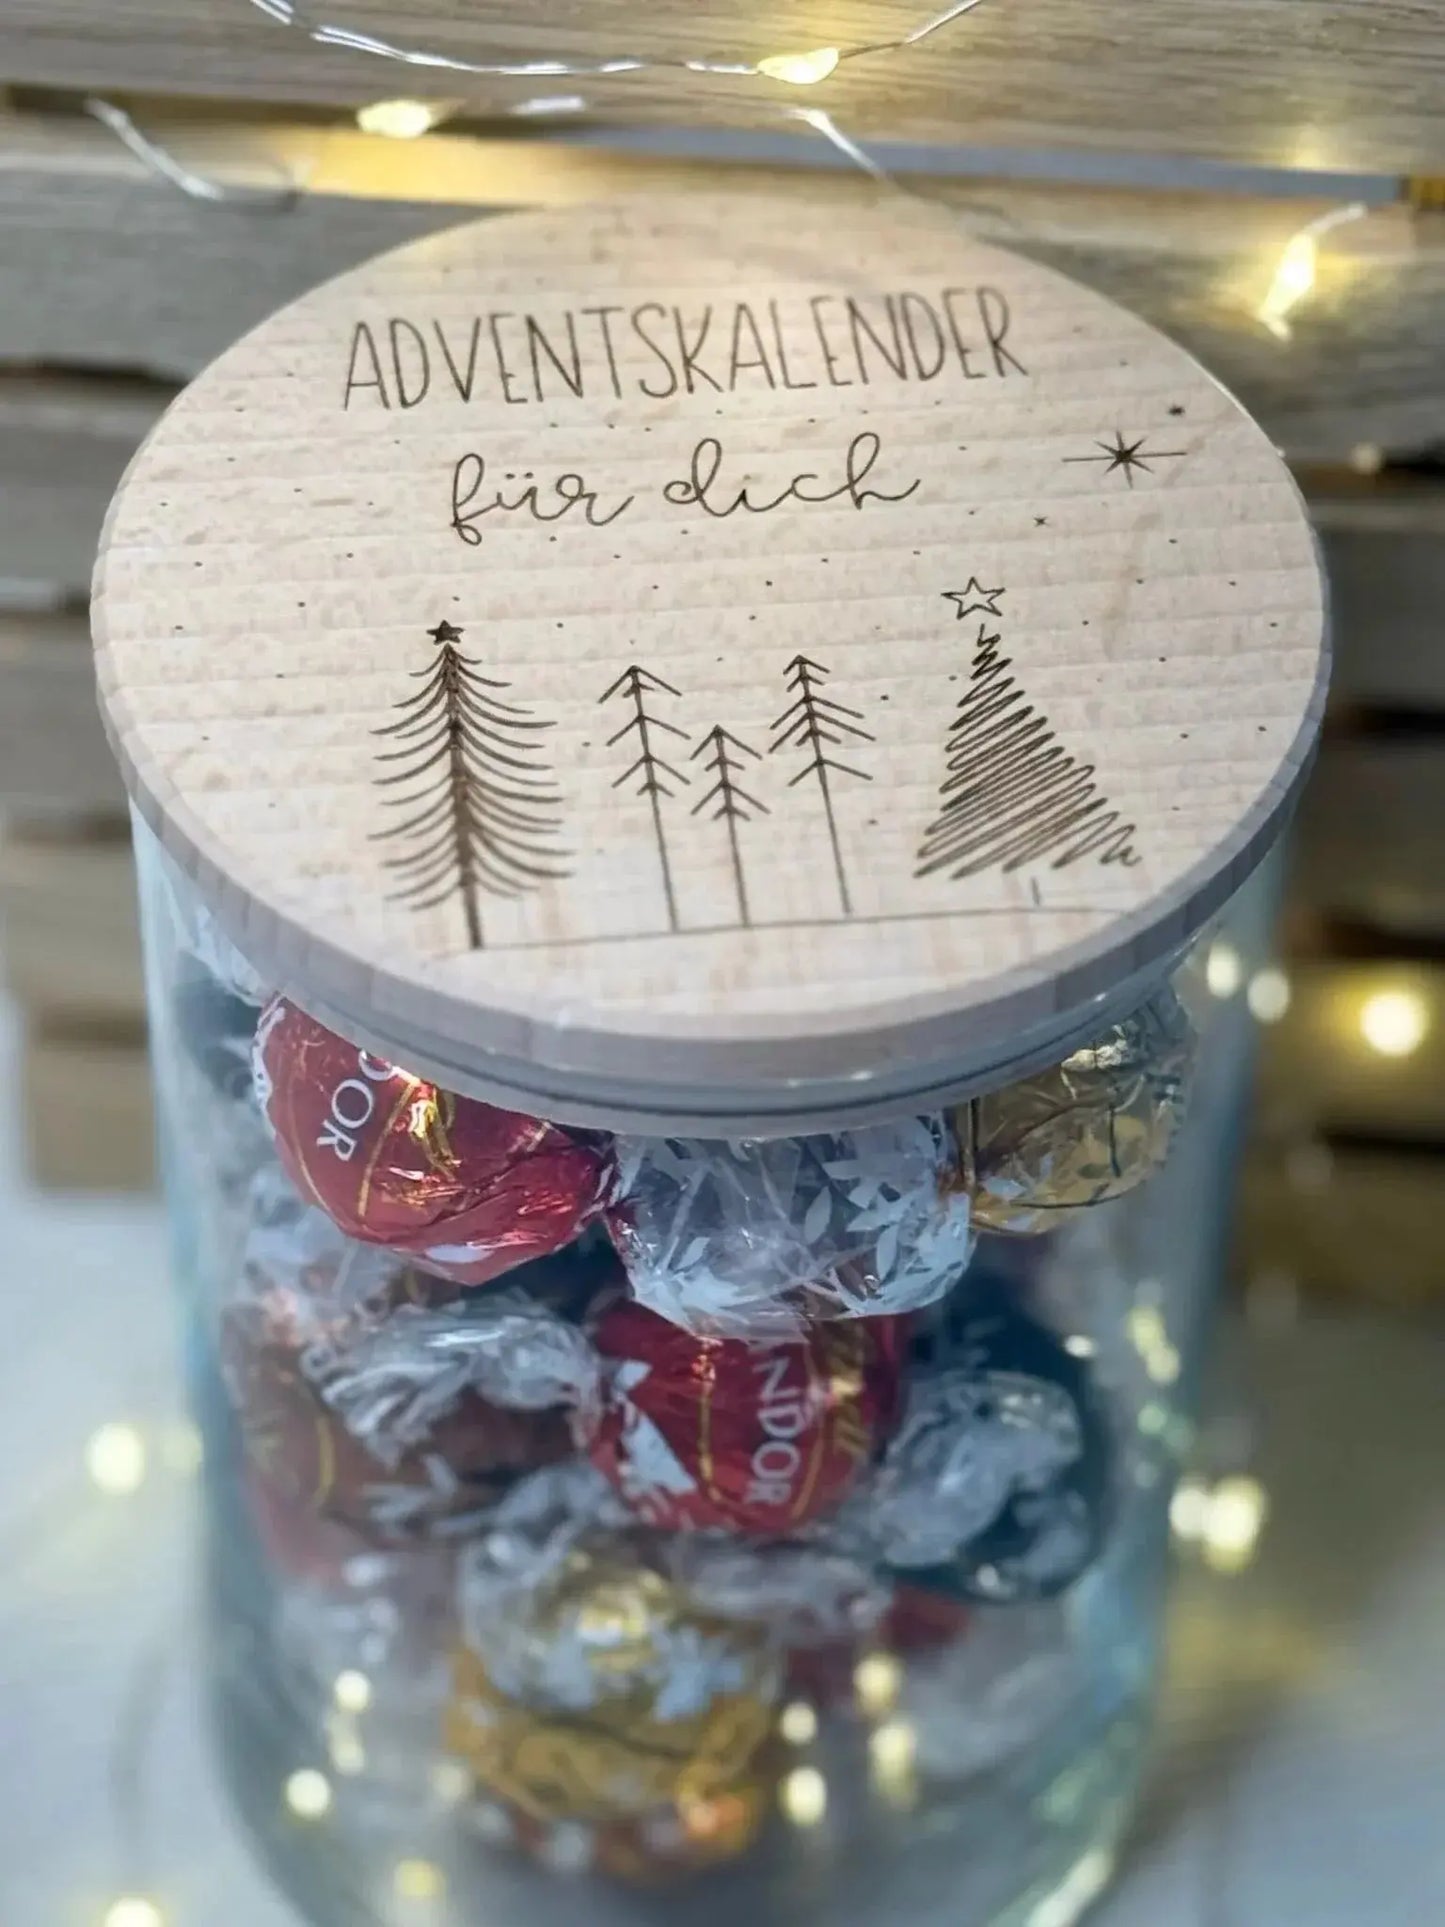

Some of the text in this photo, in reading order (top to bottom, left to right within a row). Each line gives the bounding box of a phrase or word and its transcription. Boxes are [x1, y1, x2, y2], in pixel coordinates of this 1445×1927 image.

[343, 286, 1029, 411] ADVENTSKALENDER
[451, 432, 920, 545] für dich
